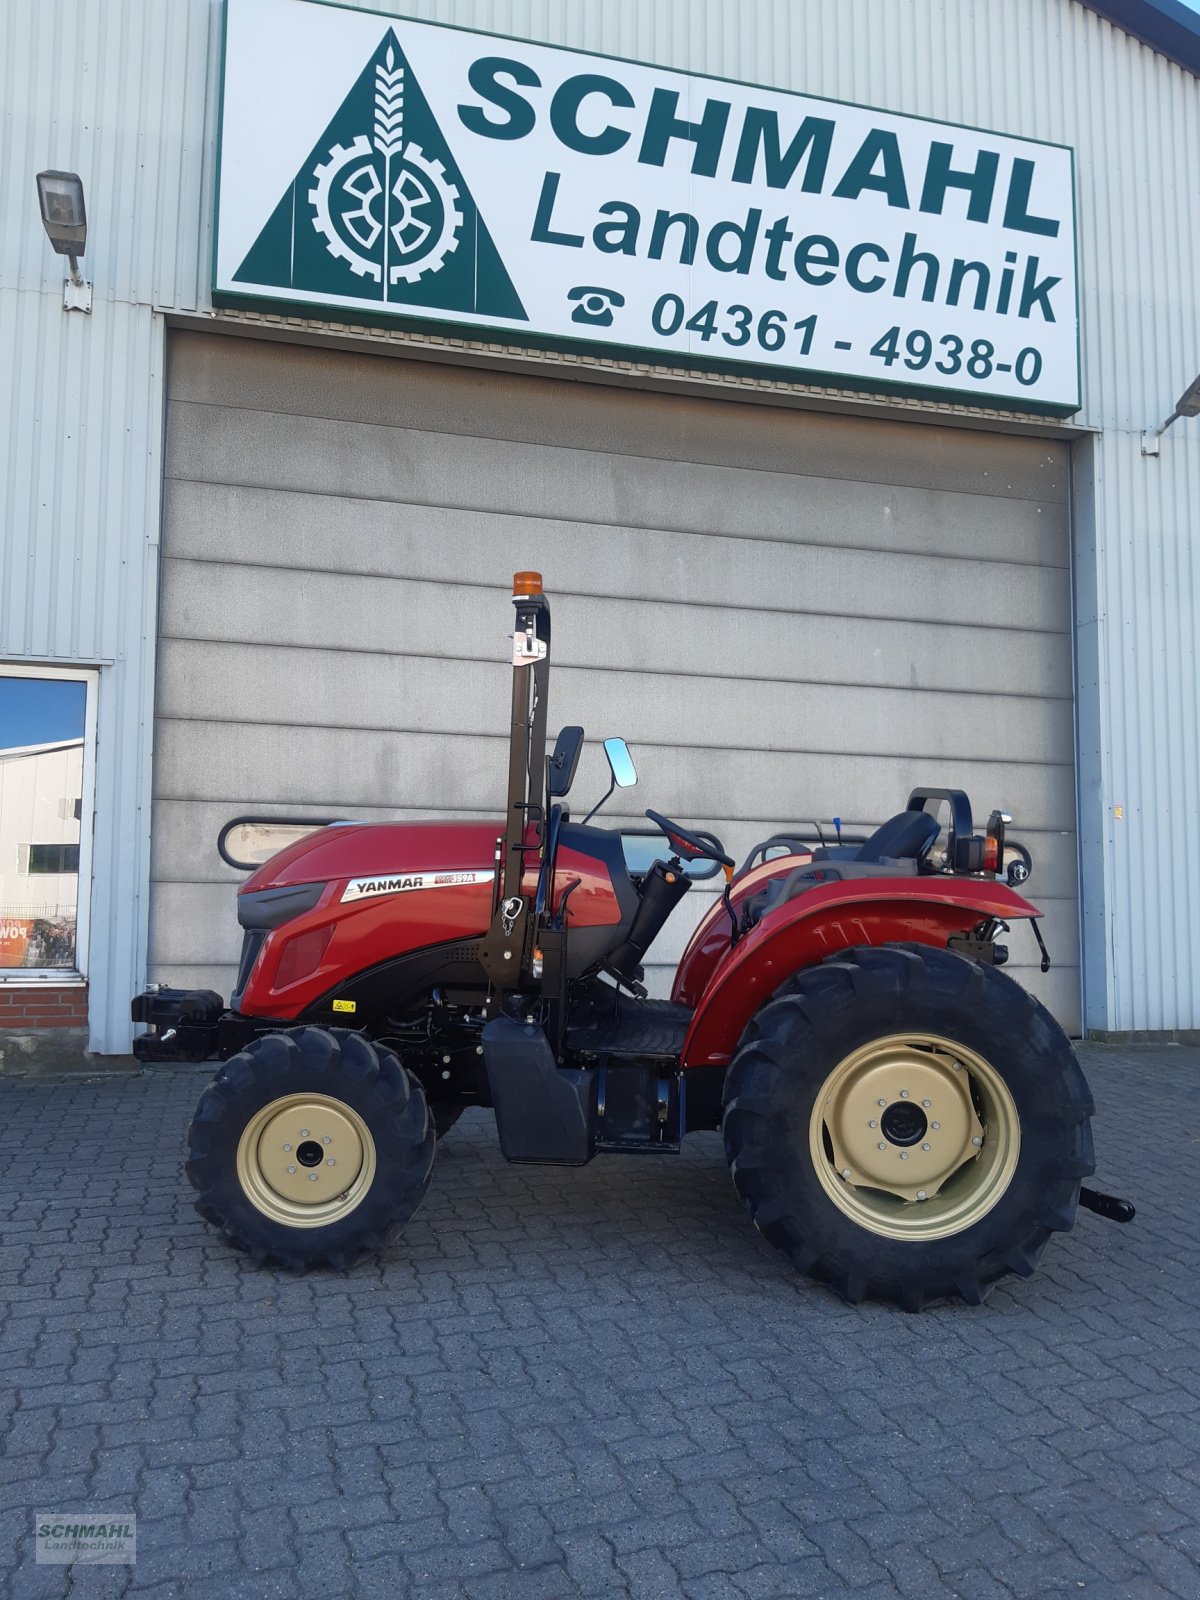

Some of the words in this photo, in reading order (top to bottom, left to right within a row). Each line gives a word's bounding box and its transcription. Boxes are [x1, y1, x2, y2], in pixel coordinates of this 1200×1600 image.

[457, 57, 1060, 238] SCHMAHL
[531, 172, 1062, 322] Landtechnik
[652, 293, 817, 355] 04361
[870, 327, 1042, 386] 4938-0
[357, 877, 423, 893] YANMAR
